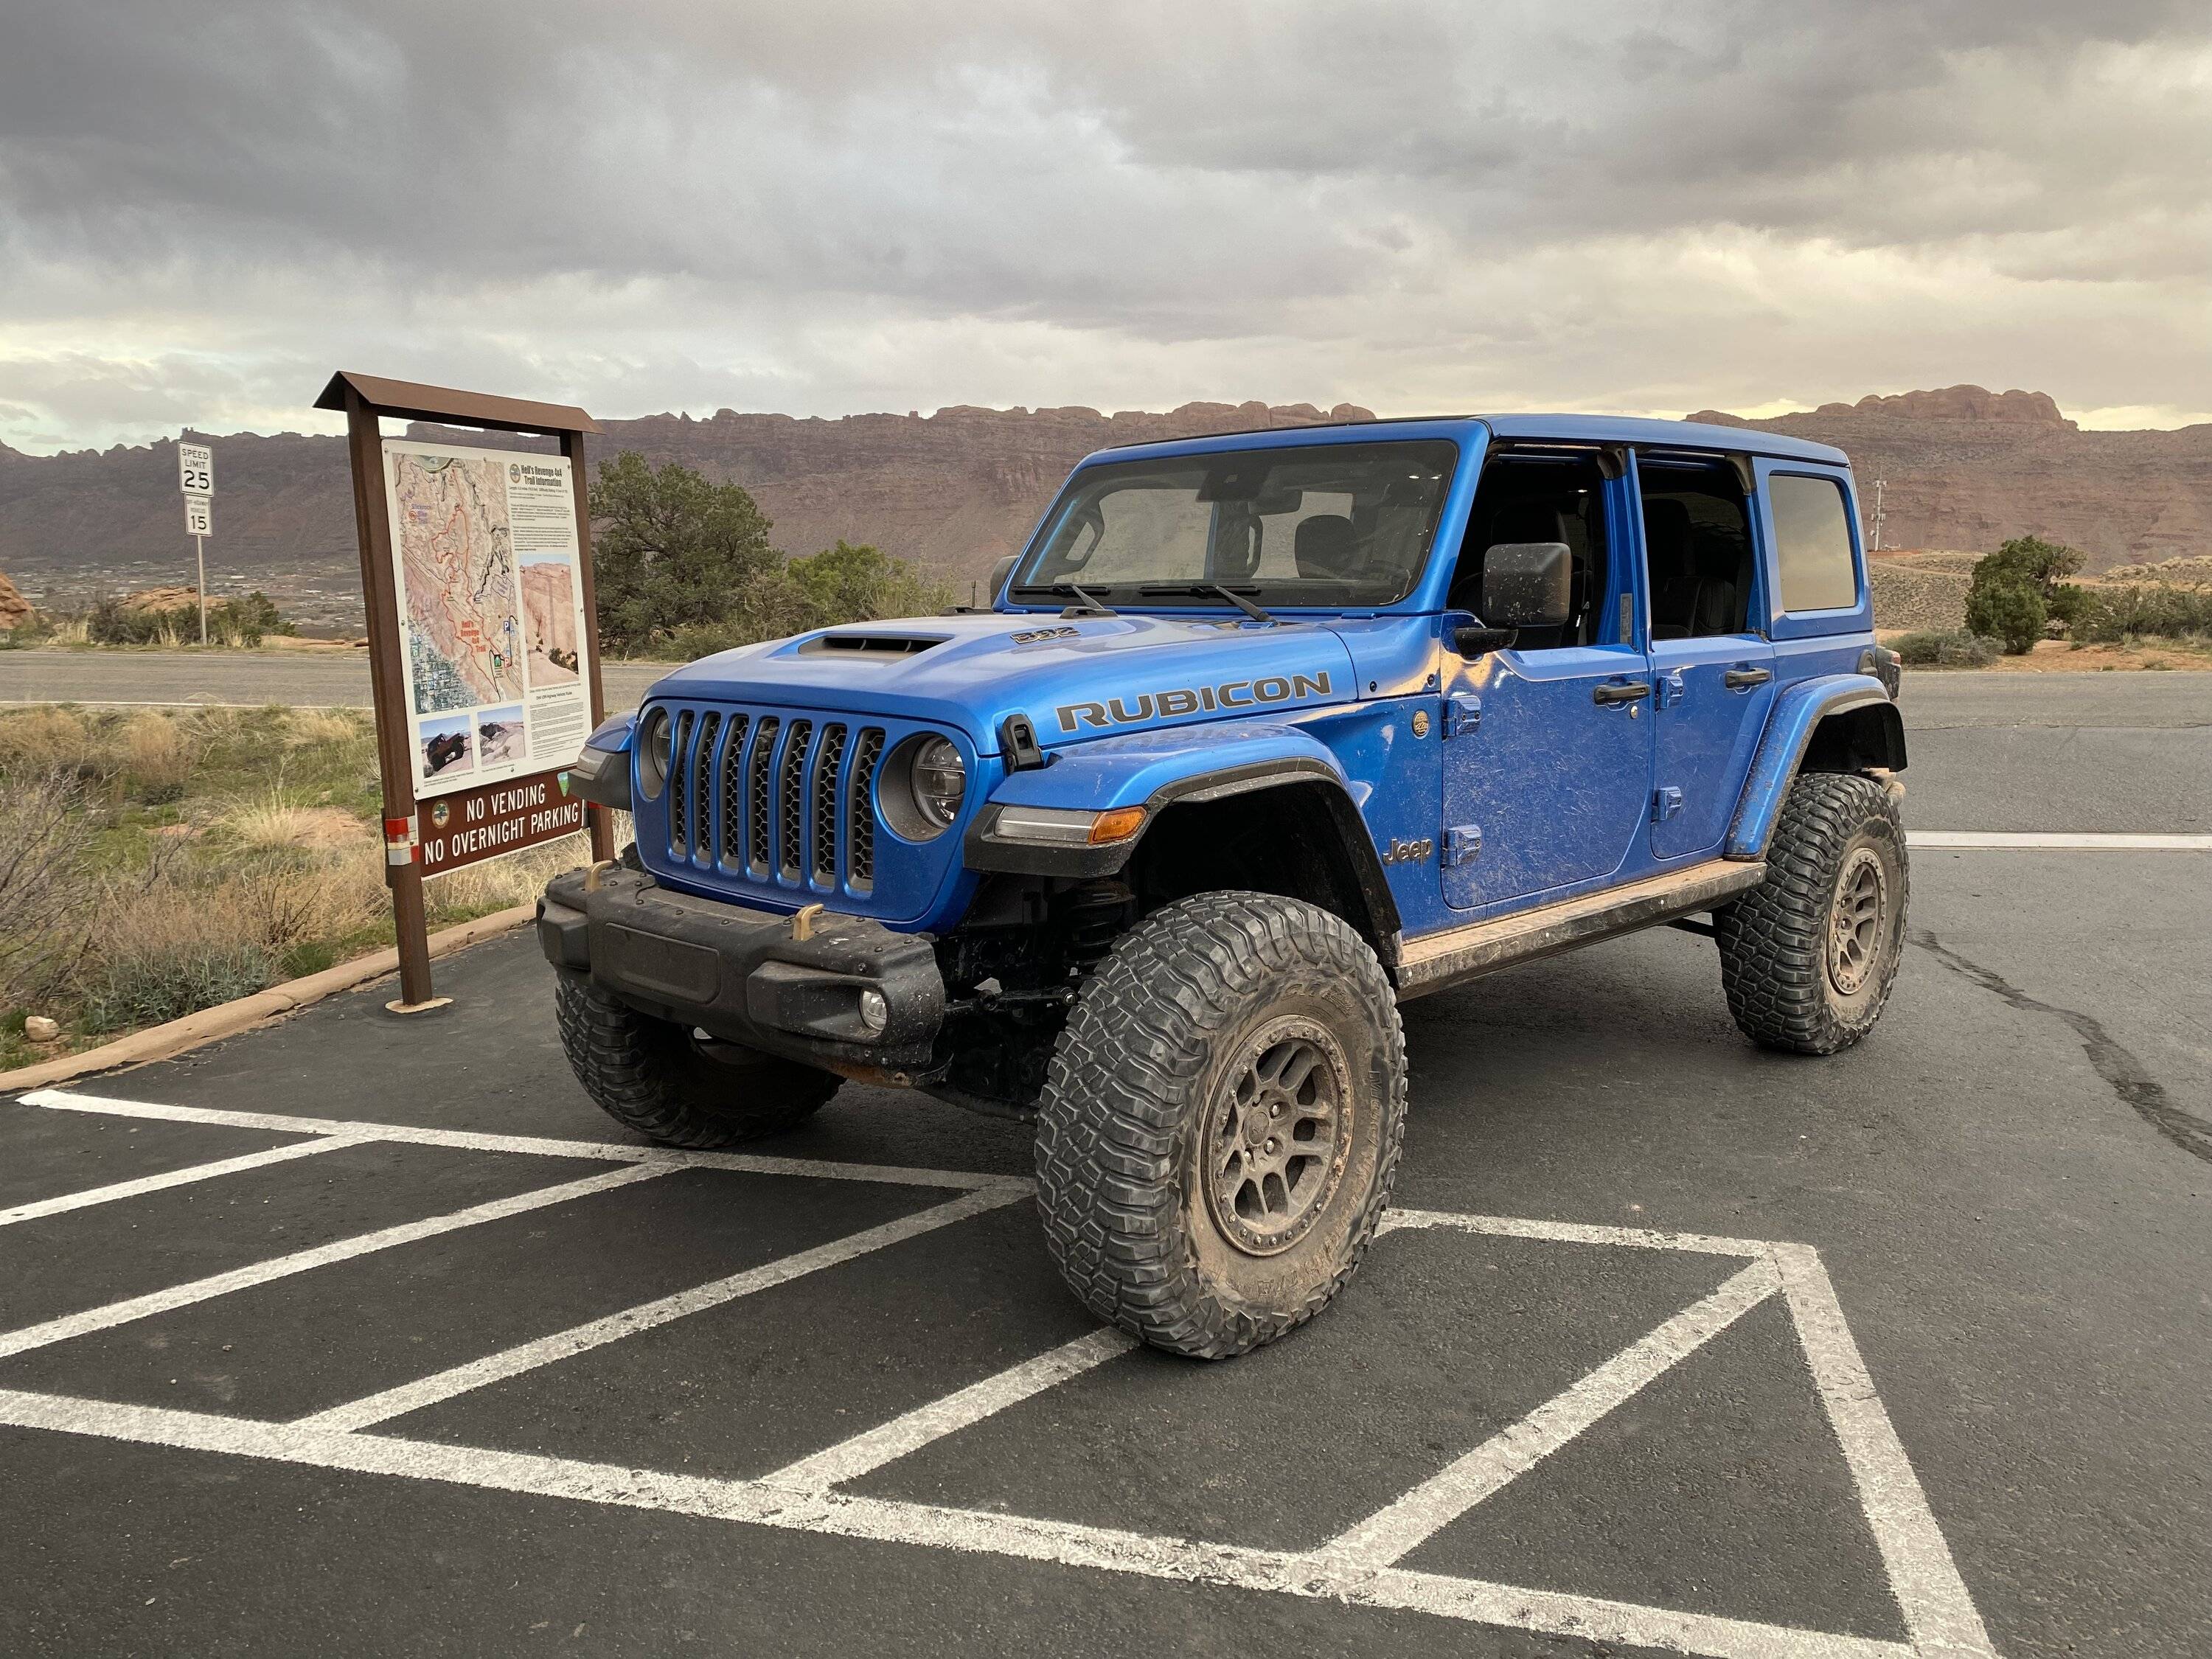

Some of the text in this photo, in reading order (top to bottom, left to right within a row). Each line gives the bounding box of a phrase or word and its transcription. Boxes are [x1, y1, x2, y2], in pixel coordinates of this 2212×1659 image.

[181, 448, 209, 459] SPEED
[184, 459, 206, 470] LIMIT
[535, 466, 554, 477] Revenge
[184, 470, 209, 490] 25
[524, 476, 562, 487] Trail Information
[190, 515, 206, 530] 15
[1009, 627, 1082, 644] 392
[1055, 671, 1332, 732] RUBICON
[466, 782, 546, 822] NO VENDING
[424, 802, 579, 865] NO OVERNIGHT PARKING
[1382, 838, 1433, 866] Jeep
